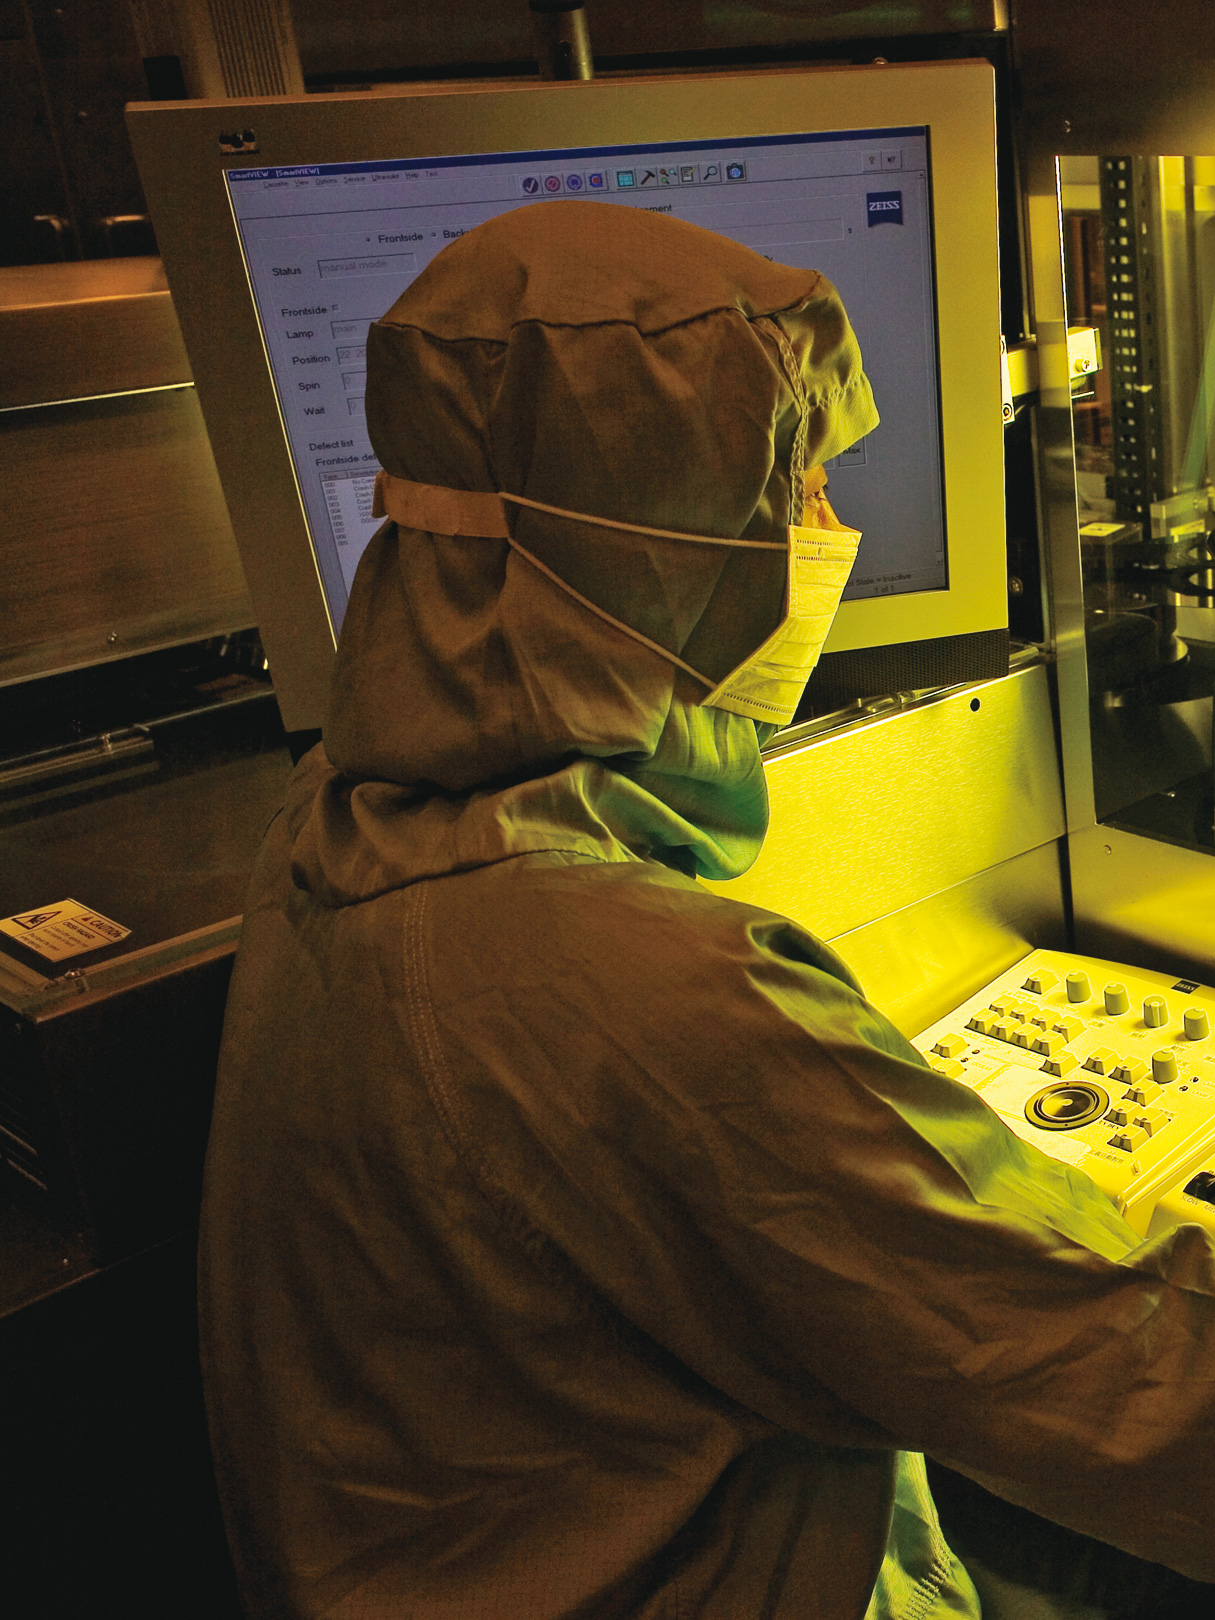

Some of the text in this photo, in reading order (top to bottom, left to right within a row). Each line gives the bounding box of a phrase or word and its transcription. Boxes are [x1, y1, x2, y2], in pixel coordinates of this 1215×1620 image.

[869, 200, 900, 211] ZEISS
[378, 228, 471, 244] Frontside Back
[272, 260, 387, 276] Status manual mode
[282, 305, 328, 317] Frontside
[286, 329, 314, 340] Lamp
[292, 354, 330, 366] Position
[298, 381, 320, 393] Spin
[304, 406, 325, 416] Wait
[309, 438, 354, 452] Defect list
[316, 456, 360, 466] Frontside
[856, 578, 874, 586] State
[884, 573, 912, 582] Inactive
[90, 920, 122, 938] CAUTION
[1180, 1194, 1200, 1206] SLOW
